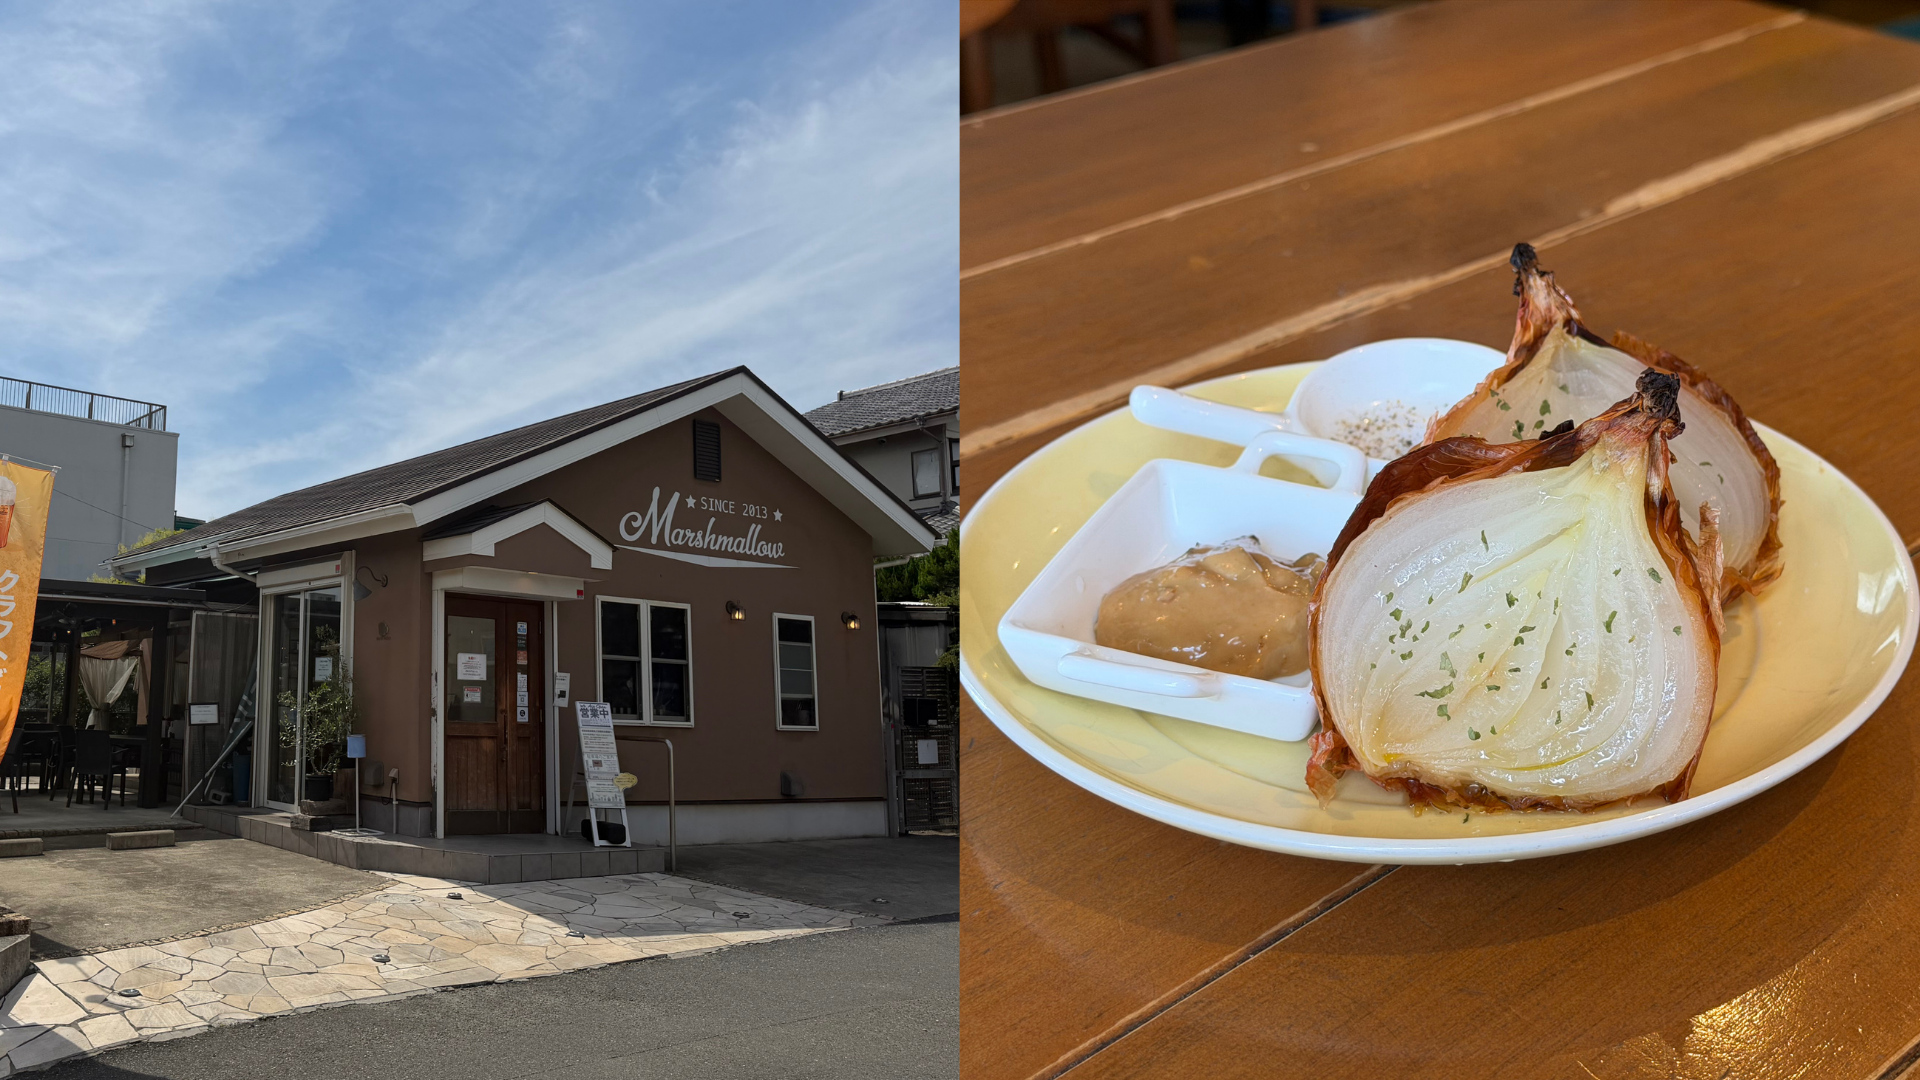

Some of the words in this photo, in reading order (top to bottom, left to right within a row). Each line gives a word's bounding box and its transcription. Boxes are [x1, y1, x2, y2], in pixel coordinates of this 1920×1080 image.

[619, 486, 785, 559] Marshmallow
[701, 497, 735, 514] SINCE
[742, 503, 768, 519] 2013
[0, 569, 20, 661] クラフ
[580, 708, 609, 719] 営業中
